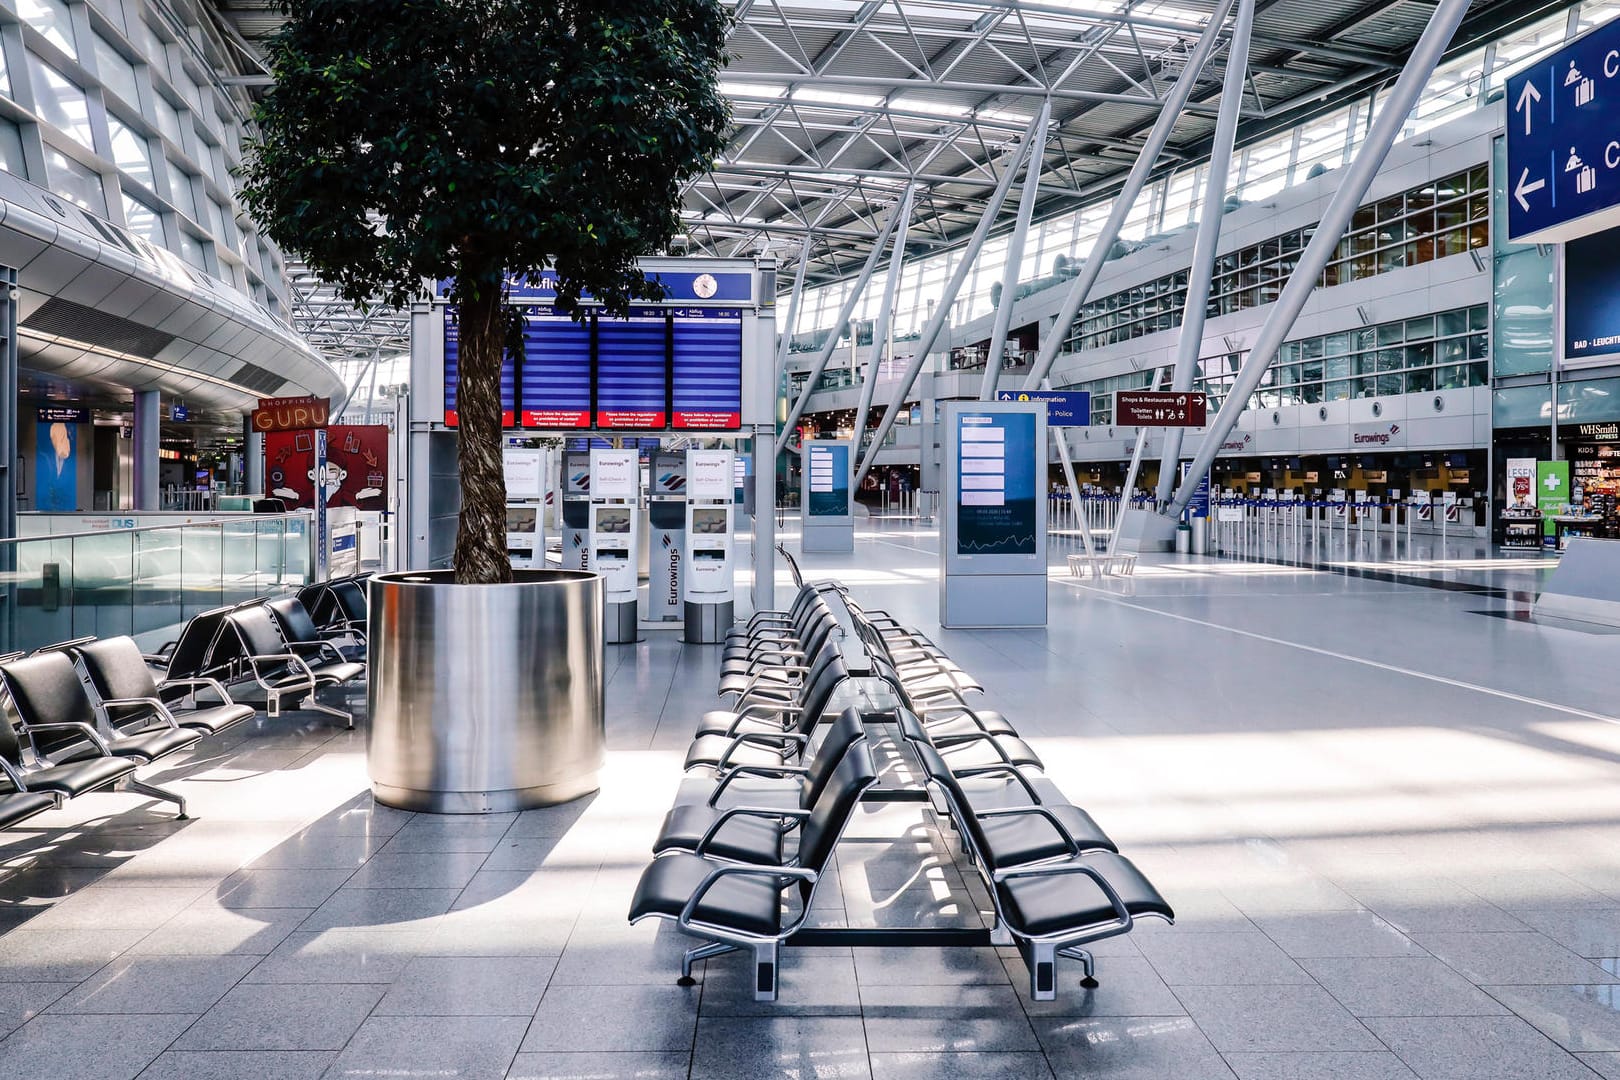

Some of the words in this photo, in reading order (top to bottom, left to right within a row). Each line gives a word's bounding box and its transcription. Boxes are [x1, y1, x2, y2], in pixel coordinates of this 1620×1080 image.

[1574, 340, 1588, 349] BAD
[256, 408, 325, 428] GURU
[1580, 424, 1618, 435] WHSmith
[1354, 432, 1390, 445] Eurowings
[599, 460, 624, 468] Eurowings
[1508, 468, 1535, 478] LESEN
[668, 548, 680, 606] Eurowings
